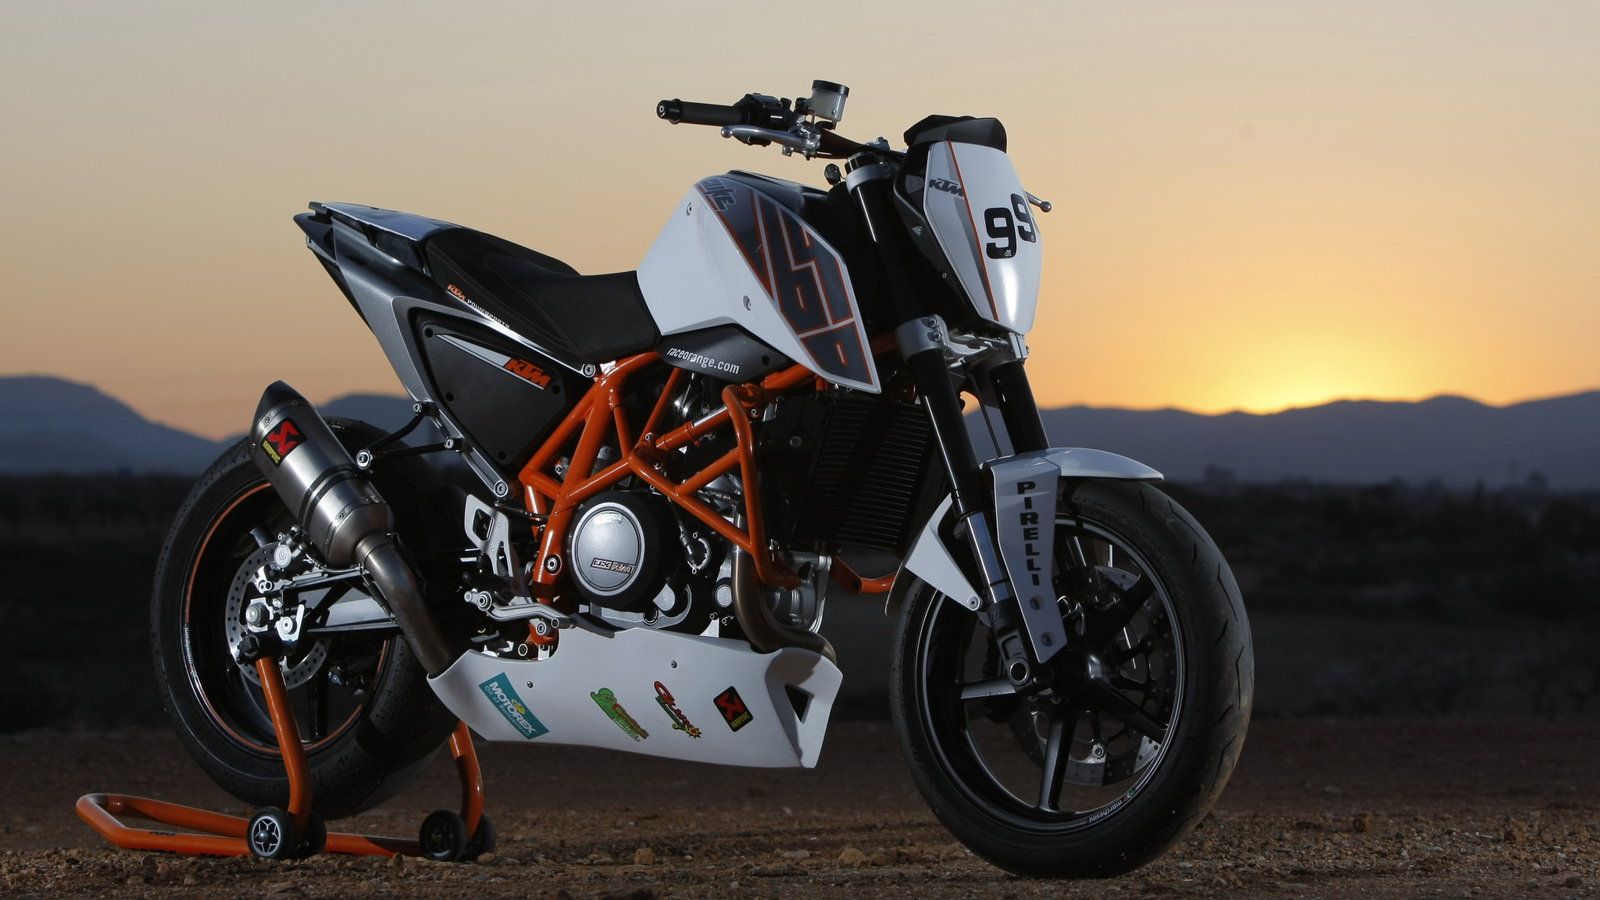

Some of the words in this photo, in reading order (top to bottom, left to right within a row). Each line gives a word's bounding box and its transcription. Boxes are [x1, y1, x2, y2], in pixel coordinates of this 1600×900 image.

[928, 177, 965, 198] KTM
[447, 283, 466, 301] KTM
[504, 357, 551, 389] KTM
[666, 347, 740, 375] raceorange.com
[1016, 480, 1042, 586] PIRELLI
[489, 681, 536, 734] MOTOREX
